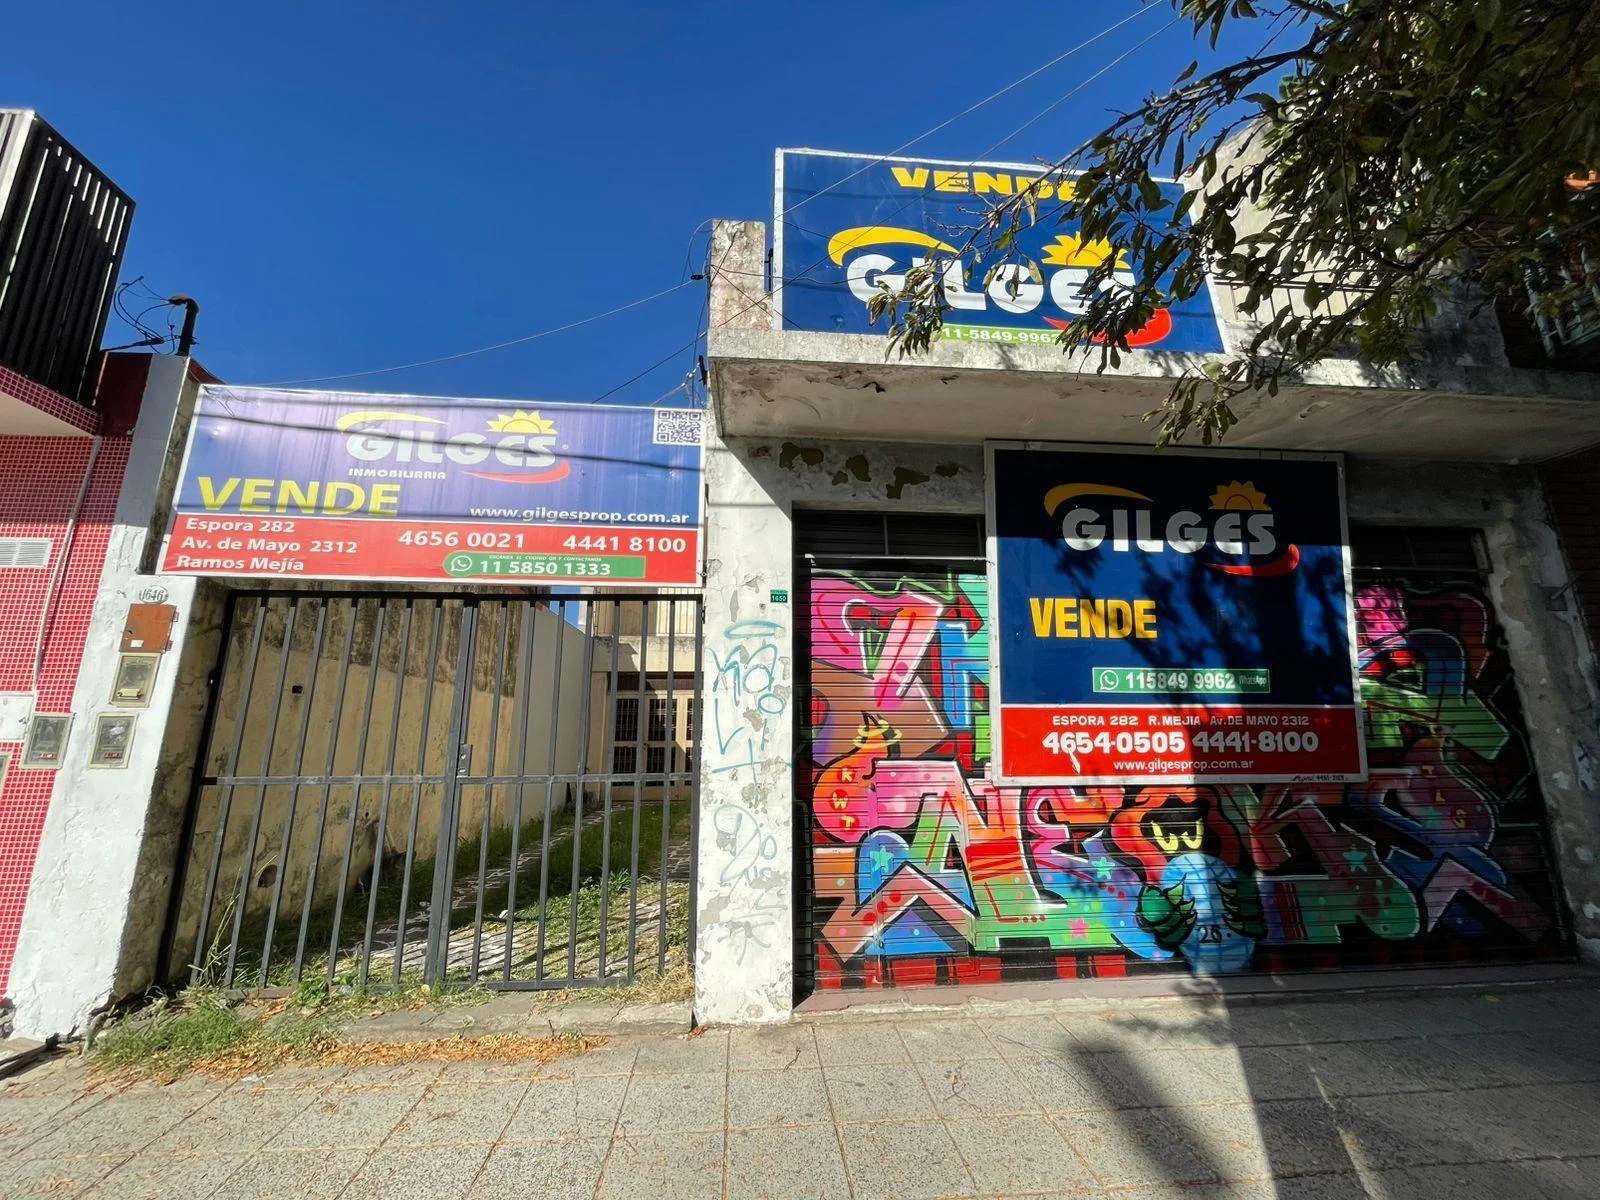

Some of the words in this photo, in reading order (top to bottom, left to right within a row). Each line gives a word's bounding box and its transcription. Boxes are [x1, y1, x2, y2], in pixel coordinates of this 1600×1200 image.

[346, 428, 558, 467] GILGES
[348, 468, 446, 480] INMOBILIARIA
[198, 476, 401, 516] VENDE
[186, 517, 254, 532] Espora
[258, 520, 295, 533] 282
[470, 507, 690, 525] www.gilgesprop.com.ar
[398, 530, 459, 546] 4656
[466, 532, 525, 548] 0021
[1062, 508, 1277, 555] GILGES
[181, 536, 212, 549] Av.
[217, 538, 242, 550] de
[247, 538, 301, 555] Mayo
[310, 540, 357, 553] 2312
[562, 535, 621, 551] 4441
[629, 538, 687, 553] 8100
[177, 555, 245, 569] Ramos
[250, 557, 304, 573] Mejía
[480, 560, 501, 573] 11
[508, 561, 558, 574] 5850
[564, 562, 611, 575] 1333
[142, 588, 164, 601] 1646
[1029, 597, 1158, 639] VENDE
[1194, 672, 1236, 690] 9962
[1052, 716, 1105, 726] ESPORA
[1109, 716, 1139, 726] 282
[1246, 716, 1278, 726] MAYO
[1282, 715, 1310, 726] 2312
[1041, 731, 1186, 754] 4654-0505
[1192, 732, 1319, 752] 4441-8100
[1113, 757, 1254, 773] www.gilgesprop.com.ar
